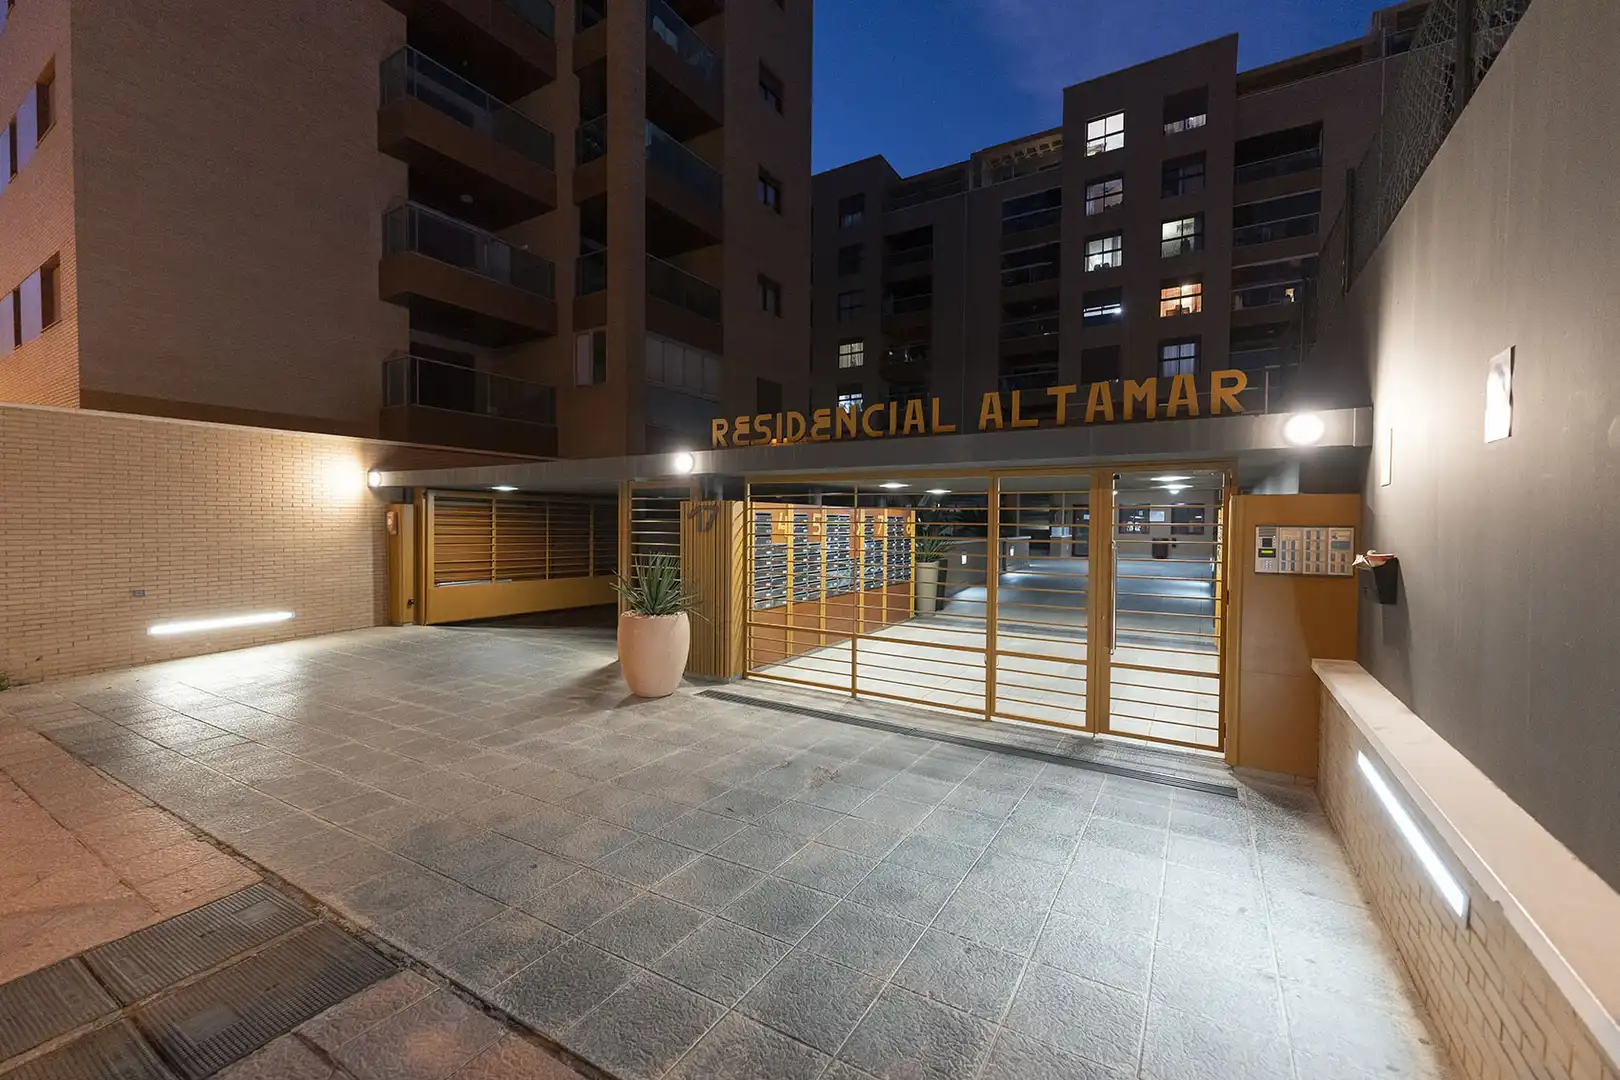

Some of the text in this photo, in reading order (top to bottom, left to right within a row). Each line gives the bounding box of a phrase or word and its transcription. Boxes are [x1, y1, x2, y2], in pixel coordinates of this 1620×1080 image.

[711, 369, 1248, 449] RESIDENCIAL ALTAMAR
[687, 504, 720, 532] 17
[778, 512, 788, 537] 4
[812, 513, 821, 535] 5
[877, 515, 884, 535] 7
